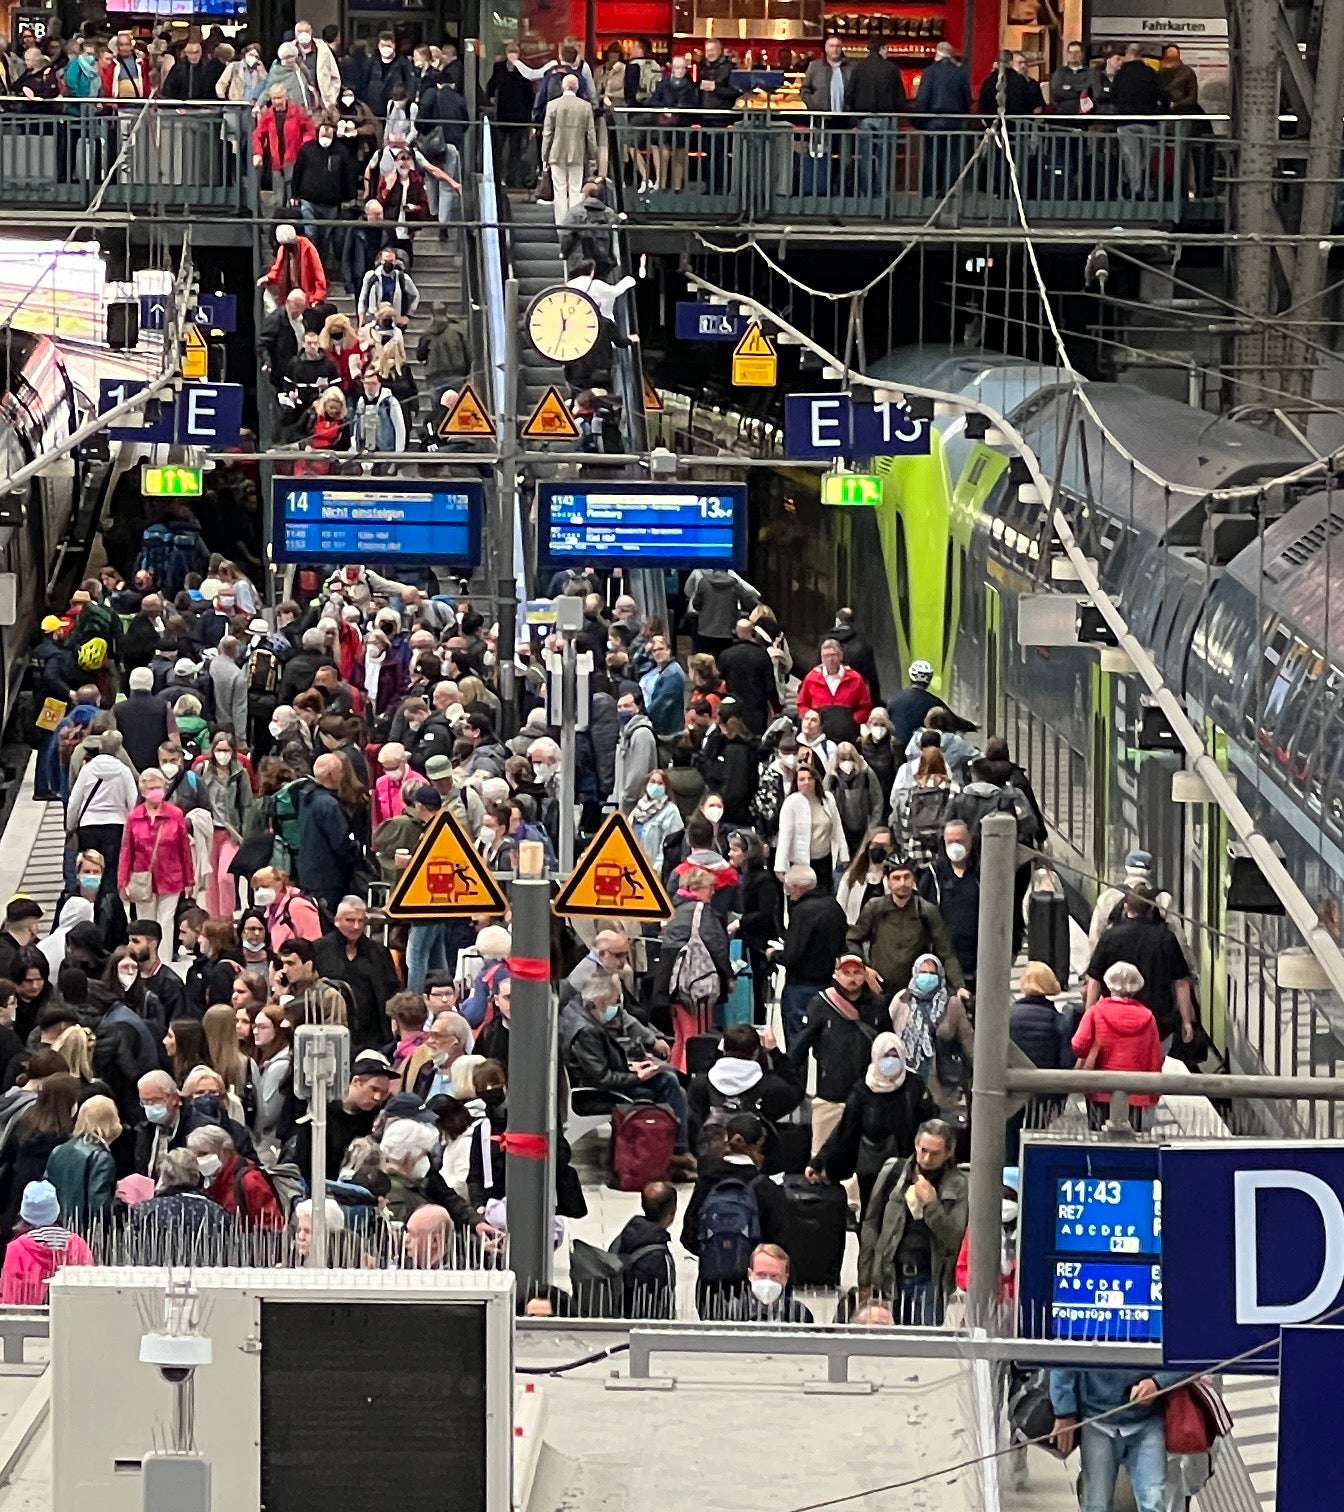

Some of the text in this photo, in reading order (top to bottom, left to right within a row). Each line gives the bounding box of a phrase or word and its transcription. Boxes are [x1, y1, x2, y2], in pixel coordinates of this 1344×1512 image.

[1142, 20, 1205, 32] Fahrkarten
[187, 389, 218, 436] E
[811, 400, 841, 447] E
[287, 491, 309, 512] 14
[698, 496, 721, 518] 13
[1061, 1179, 1122, 1205] 11:43
[1058, 1204, 1084, 1219] RE7
[1061, 1224, 1072, 1236] A
[1056, 1262, 1082, 1278] RE7
[1059, 1278, 1069, 1291] A
